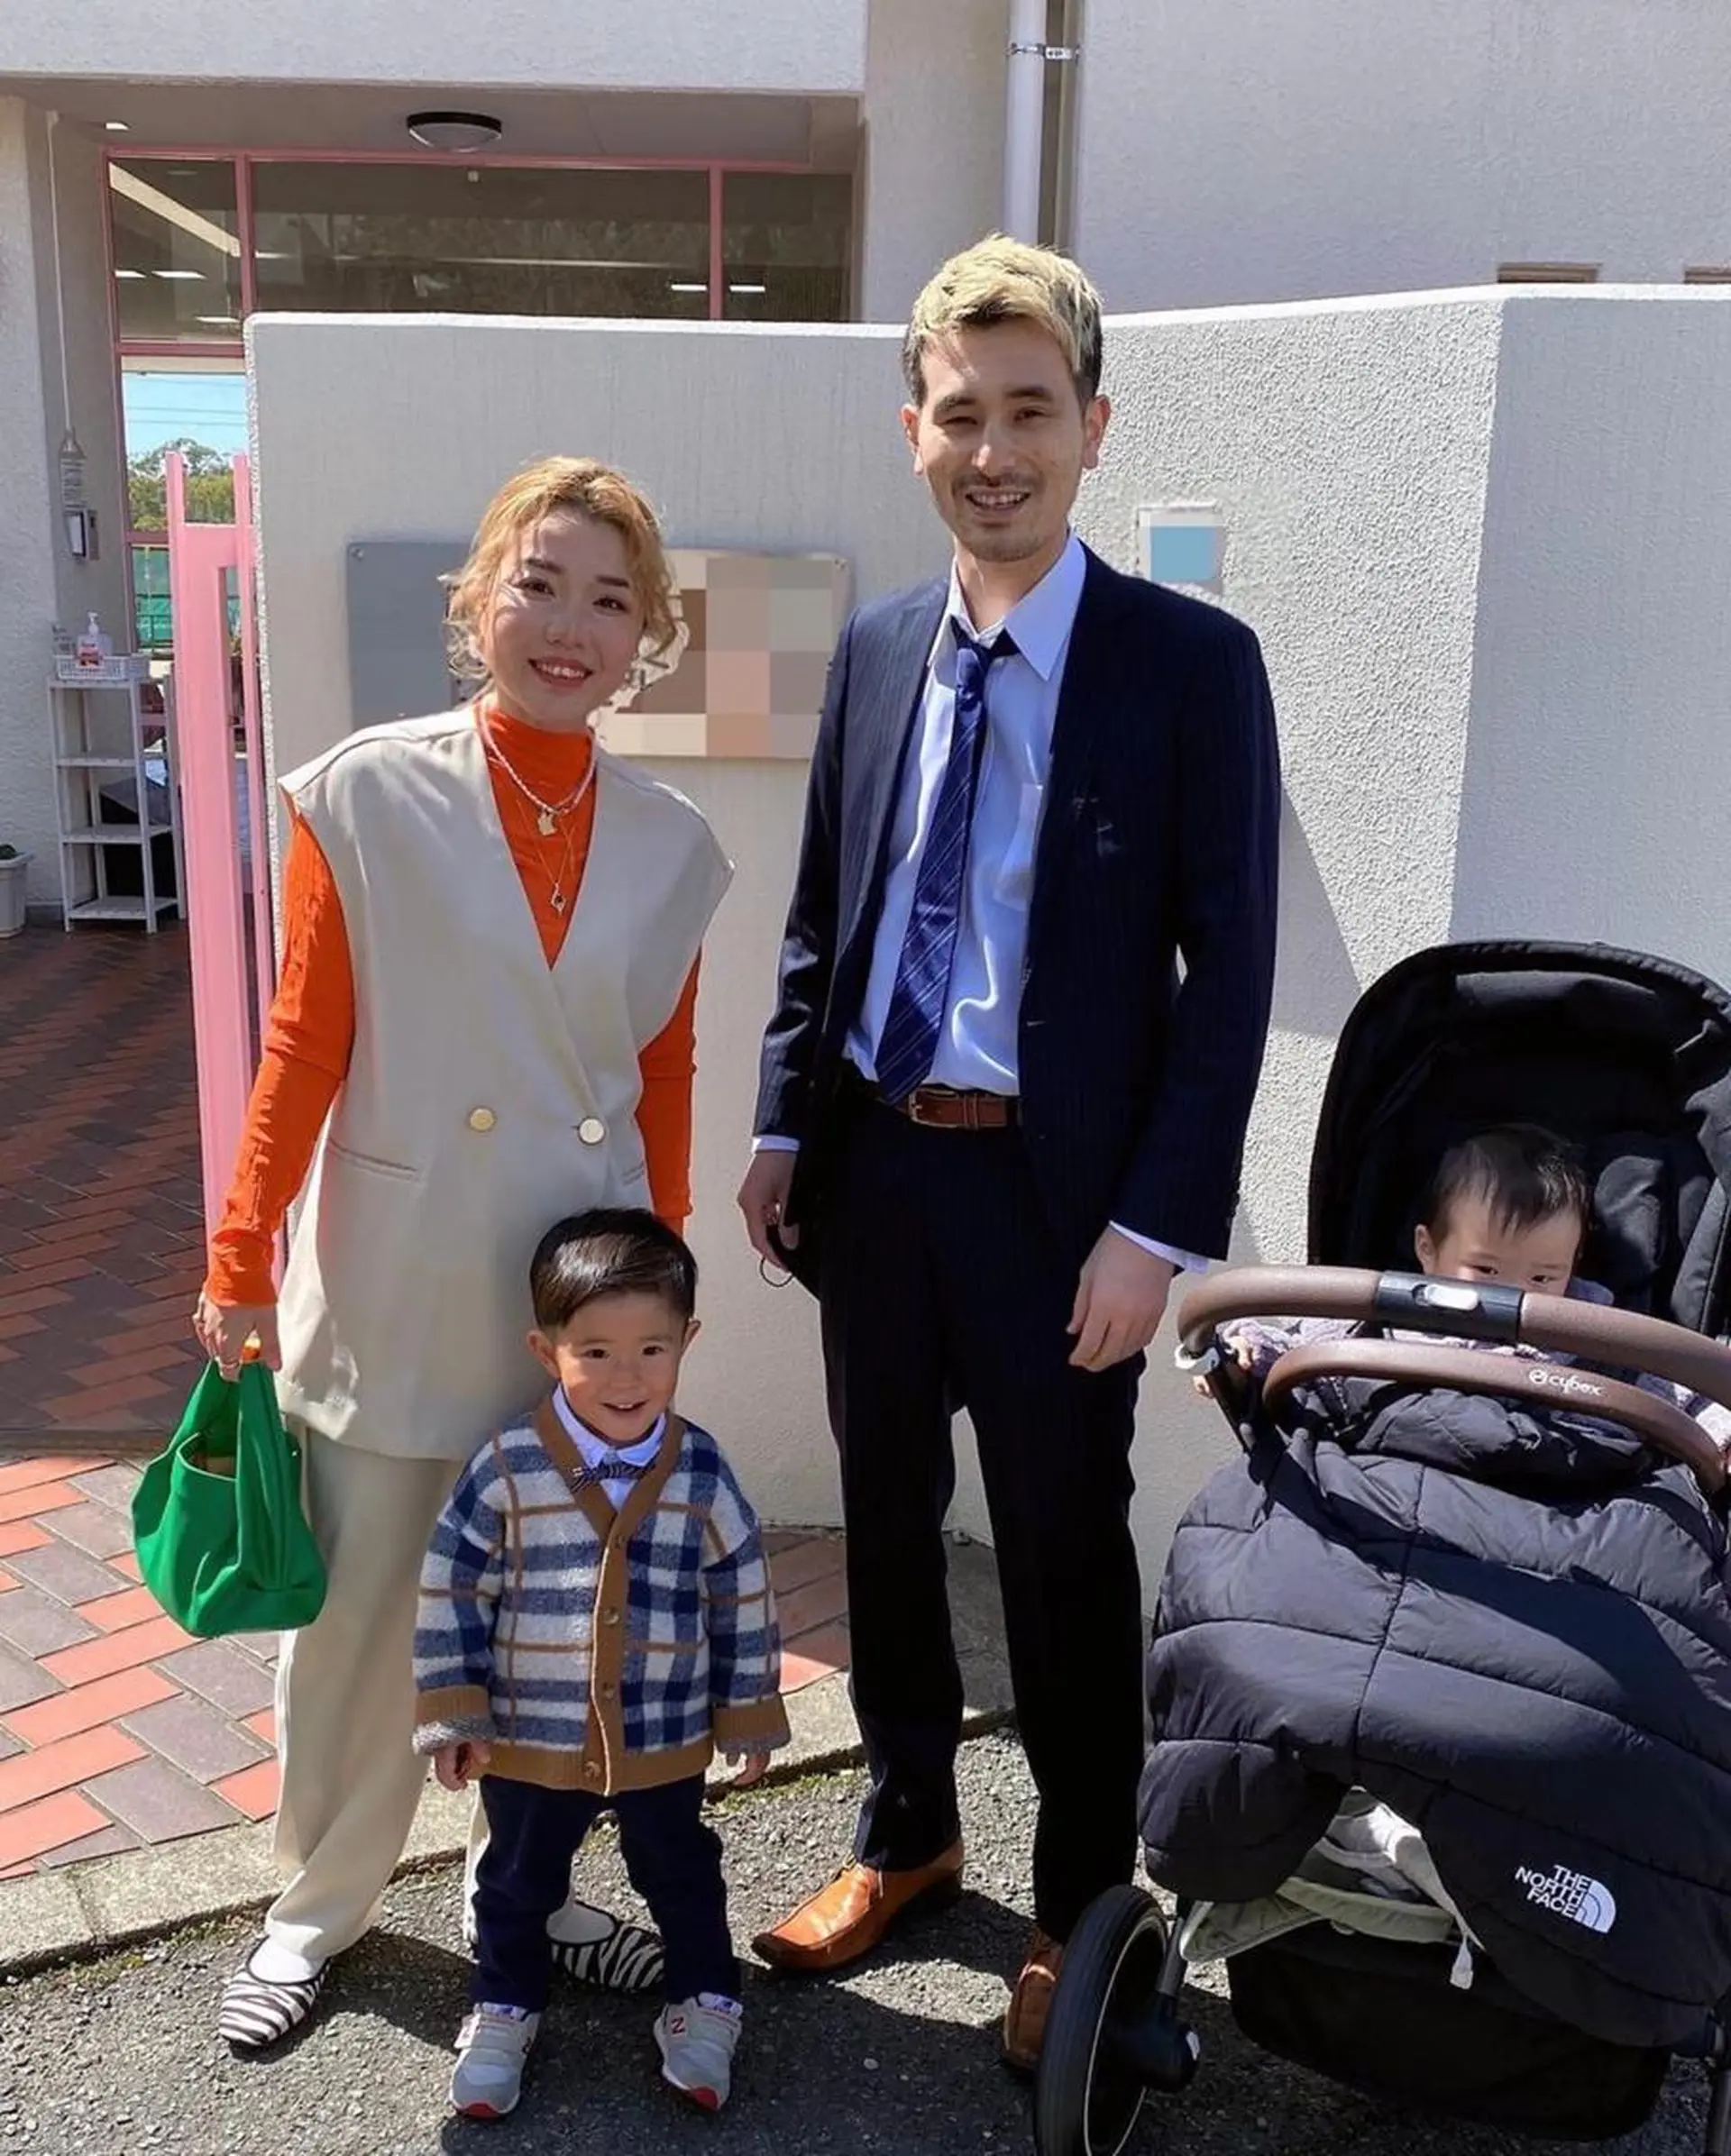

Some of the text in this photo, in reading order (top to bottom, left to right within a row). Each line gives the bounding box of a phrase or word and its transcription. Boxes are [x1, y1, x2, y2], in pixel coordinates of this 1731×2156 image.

[1515, 1866, 1585, 1908] NORTH
[1553, 1864, 1592, 1893] THE
[1526, 1886, 1577, 1918] FACE
